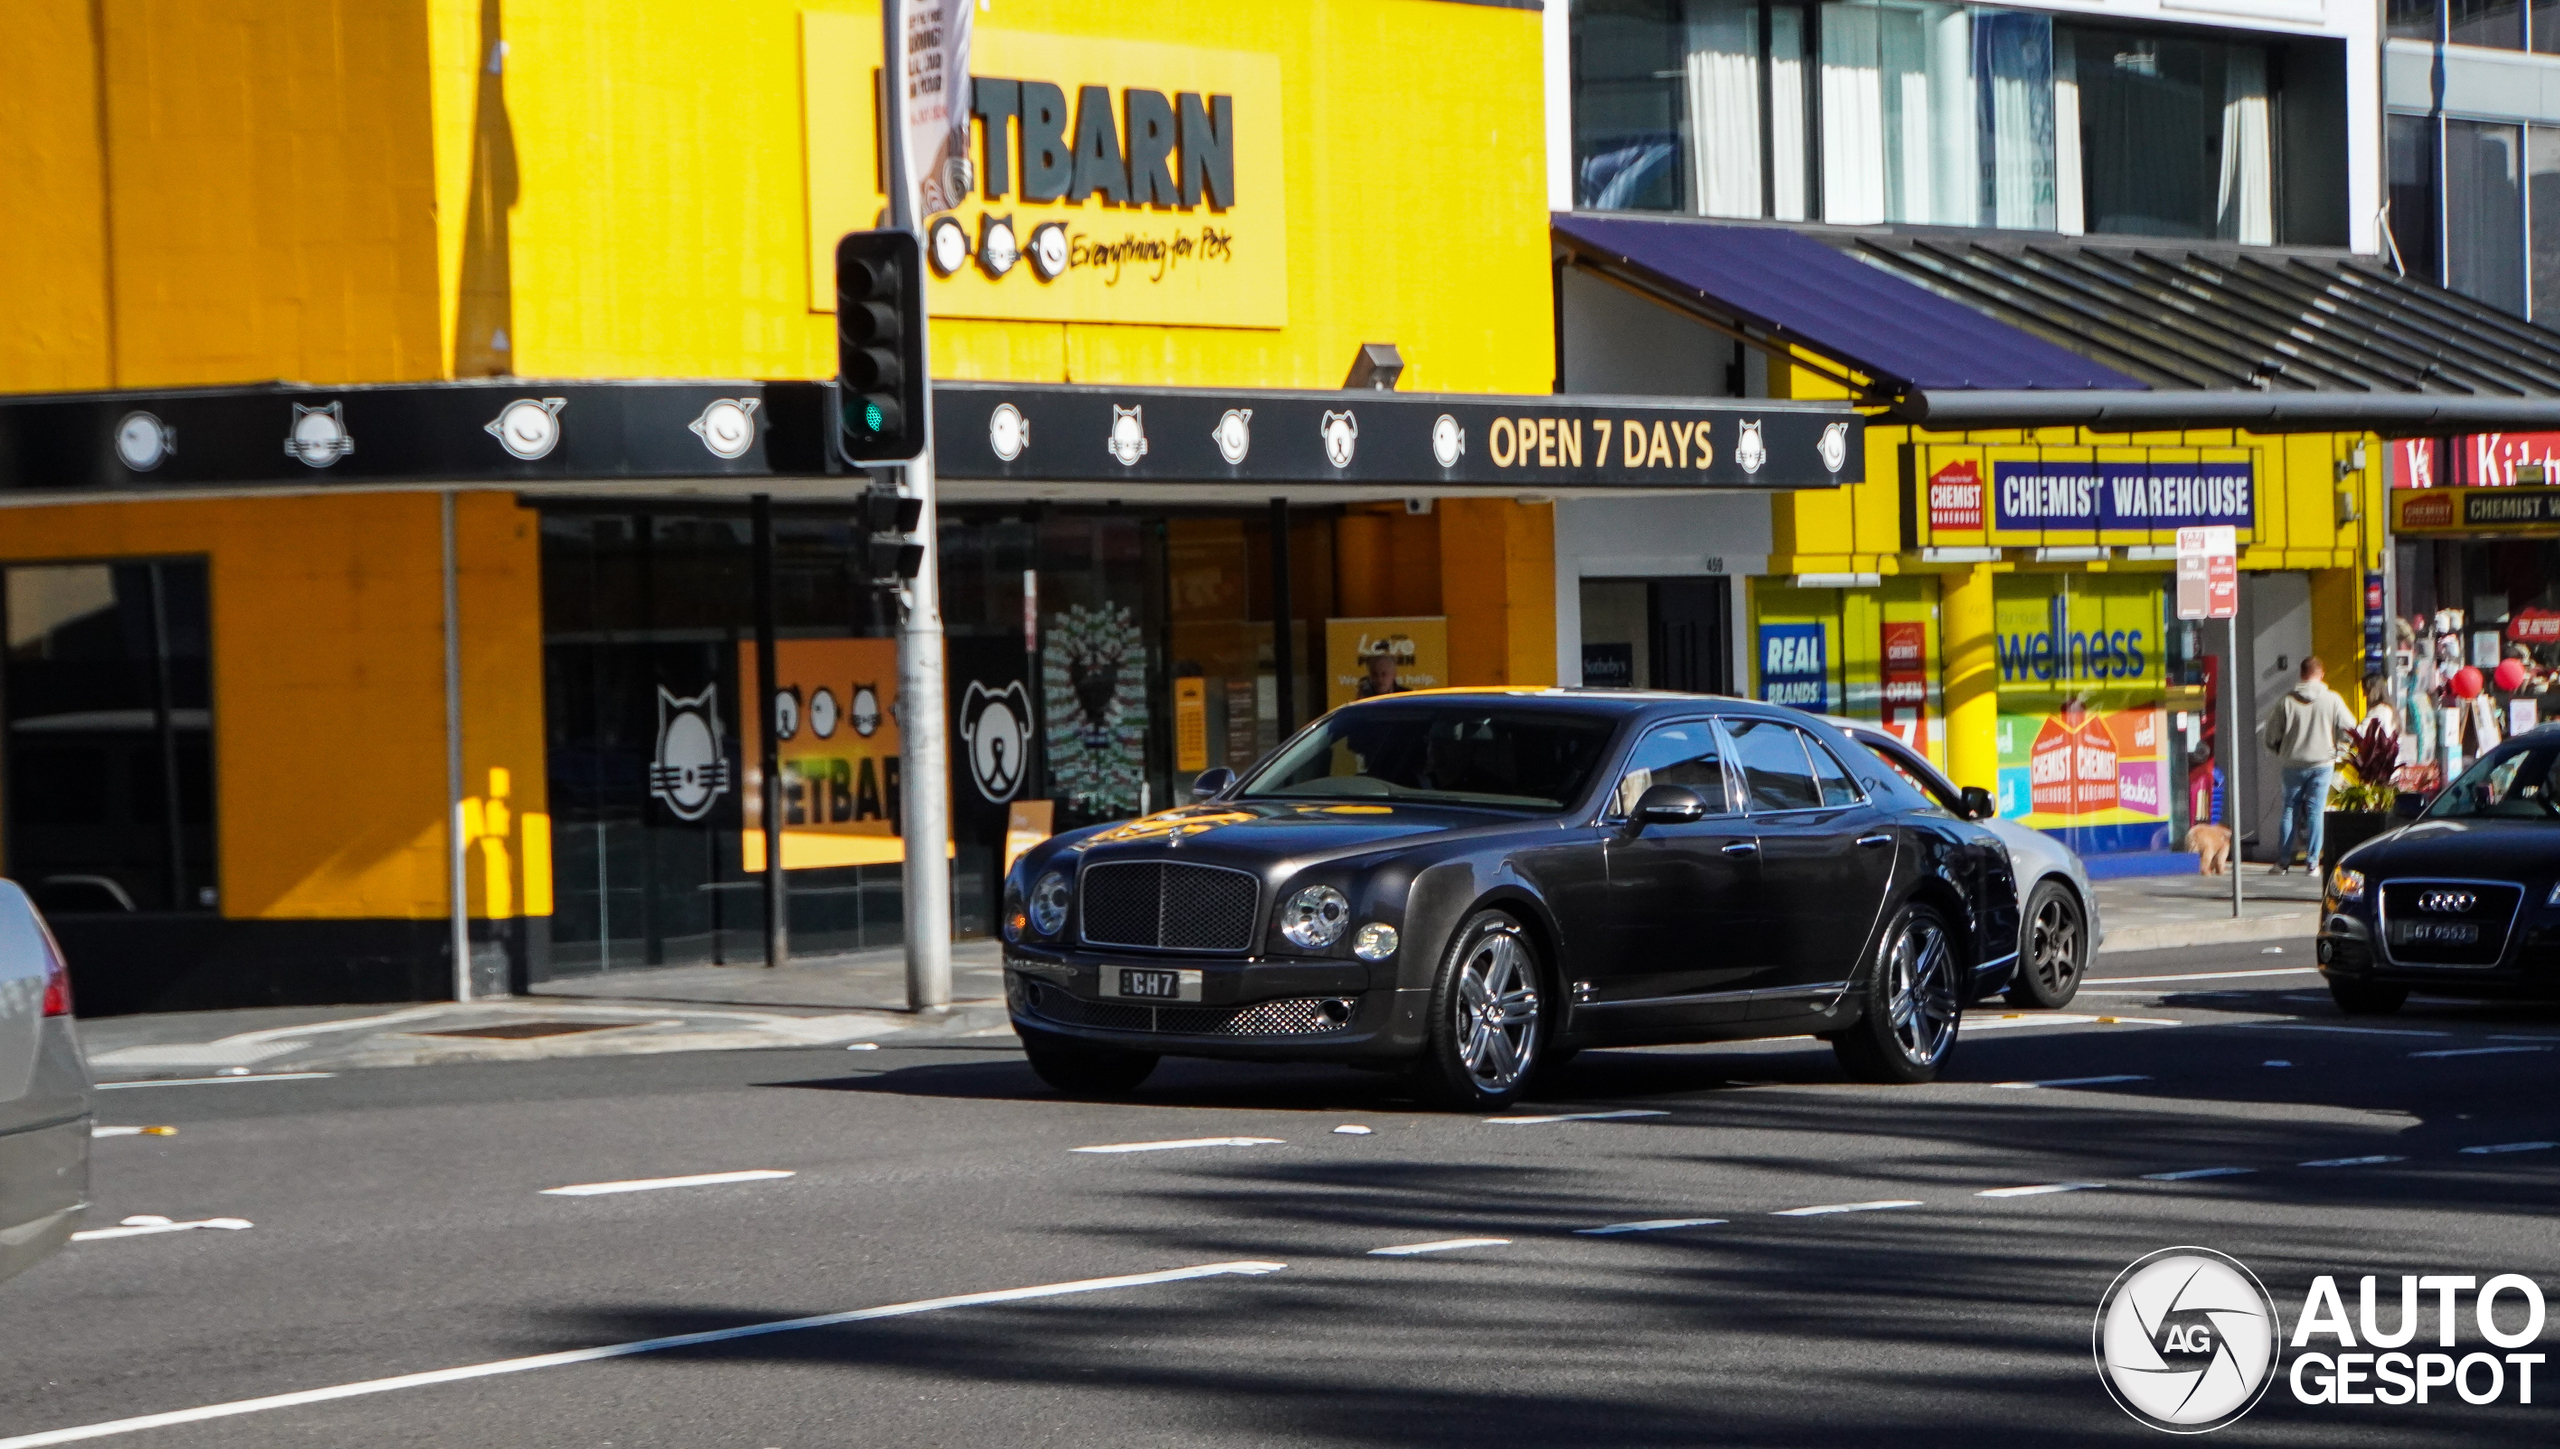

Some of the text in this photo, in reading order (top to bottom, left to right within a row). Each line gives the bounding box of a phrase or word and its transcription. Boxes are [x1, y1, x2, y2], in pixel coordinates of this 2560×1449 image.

[873, 68, 1235, 213] TBARN
[1070, 226, 1232, 287] Everything for Pets
[1489, 416, 1714, 470] OPEN 7 DAYS
[1931, 485, 1981, 509] CHEMIST
[2003, 475, 2249, 517] CHEMIST WAREHOUSE
[2470, 498, 2543, 520] CHEMIST
[1931, 510, 1980, 524] WAREHOUSE
[1767, 637, 1821, 675] REAL
[1888, 645, 1918, 660] CHEMIST
[1997, 593, 2146, 682] wellness
[1886, 681, 1925, 701] OPEN
[2032, 745, 2072, 785] CHEMIST
[2076, 744, 2117, 781] CHEMIST
[2119, 775, 2158, 806] fabulous
[1132, 972, 1173, 996] CH7
